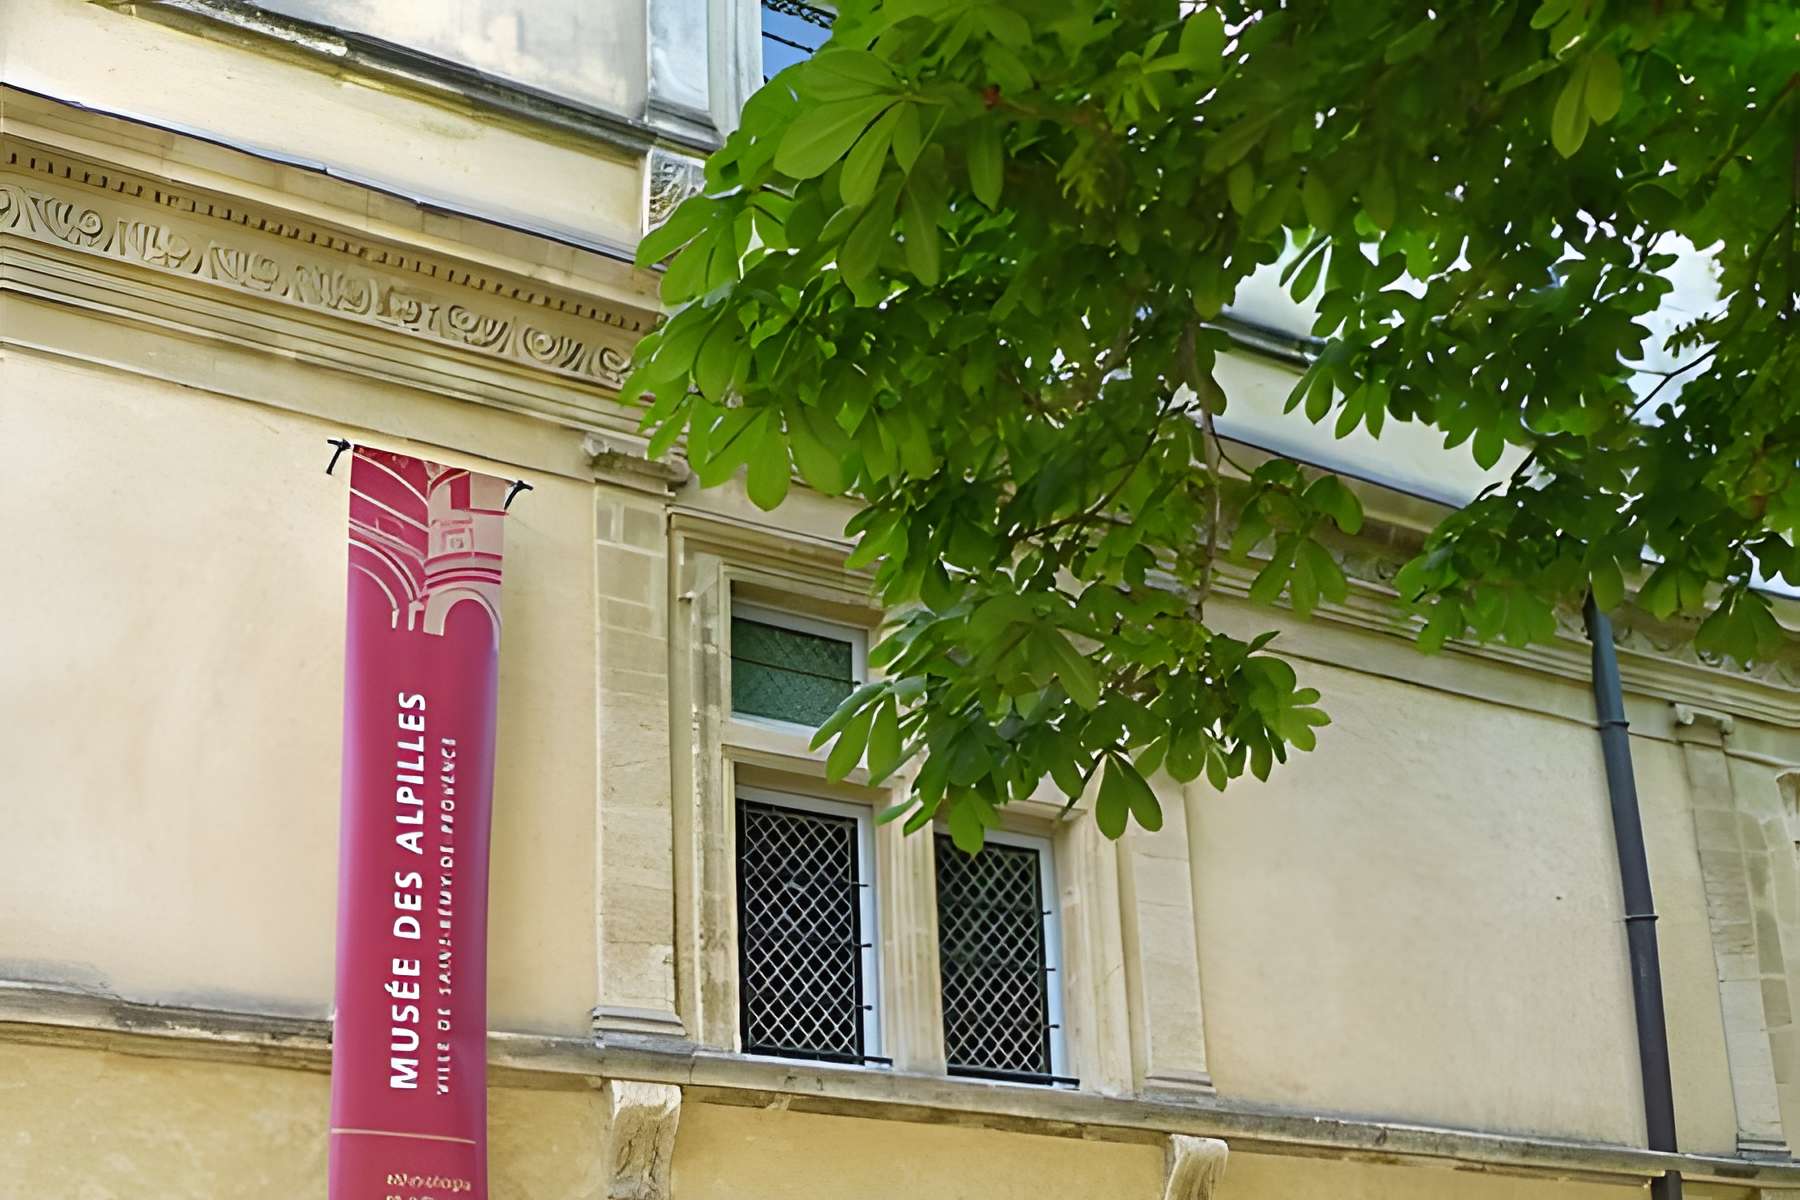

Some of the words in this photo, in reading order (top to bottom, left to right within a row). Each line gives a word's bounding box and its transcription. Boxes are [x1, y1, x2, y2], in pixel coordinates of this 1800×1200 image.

[394, 691, 426, 855] ALPILLES
[390, 870, 423, 940] DES
[384, 957, 420, 1089] MUSÉE
